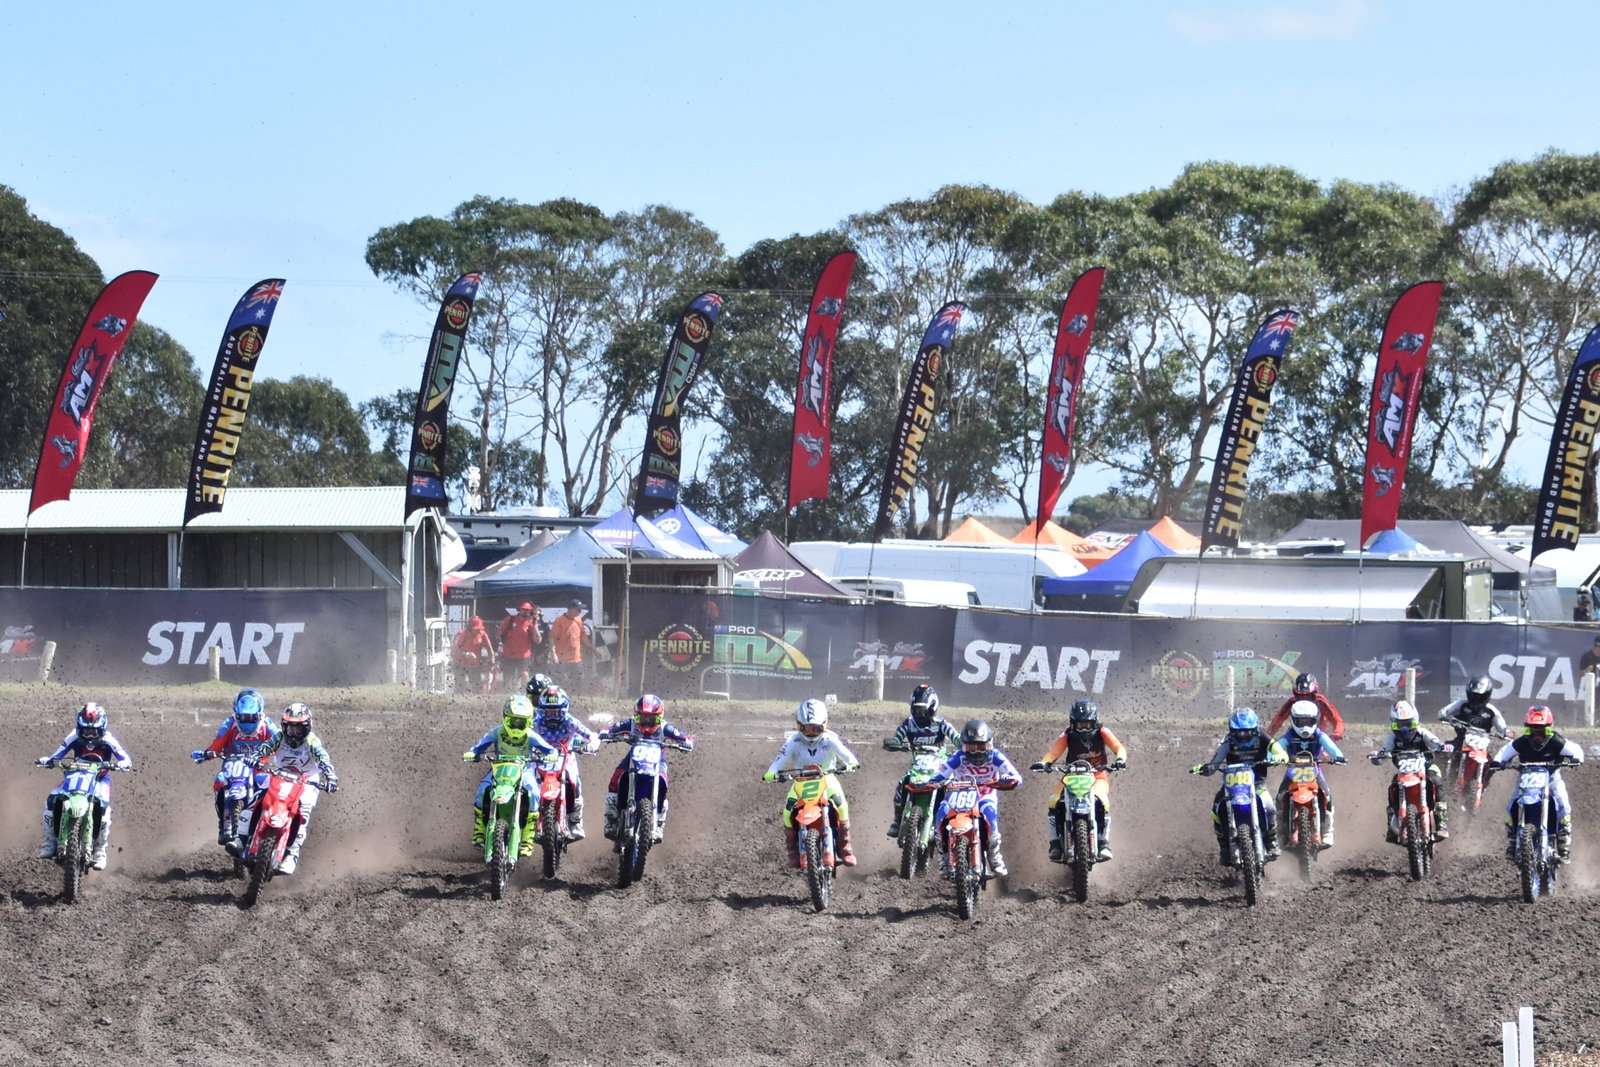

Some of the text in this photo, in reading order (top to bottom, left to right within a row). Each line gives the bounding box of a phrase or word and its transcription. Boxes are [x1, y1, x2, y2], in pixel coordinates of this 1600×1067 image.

[241, 325, 258, 363] PENRITE
[686, 362, 698, 384] PRO
[906, 353, 927, 417] AUSTRALIAN
[1258, 356, 1274, 394] PENRITE
[1231, 366, 1252, 431] AUSTRALIAN
[194, 335, 235, 503] AUSTRALIAN MADE AND OWNED
[202, 365, 254, 505] PENRITE
[1216, 395, 1268, 541] PENRITE
[1223, 436, 1235, 466] MADE
[1541, 369, 1585, 539] AUSTRALIAN MADE AND OWNED
[1551, 399, 1600, 543] PENRITE
[141, 621, 304, 666] START
[649, 639, 711, 654] PENRITE
[728, 625, 756, 635] PRO
[958, 639, 1120, 694] START
[1227, 650, 1255, 658] PRO
[1151, 665, 1211, 681] PENRITE
[278, 781, 293, 798] 1
[801, 781, 820, 799] 2
[1067, 776, 1093, 792] 22
[1291, 767, 1315, 783] 25
[948, 790, 978, 809] 469
